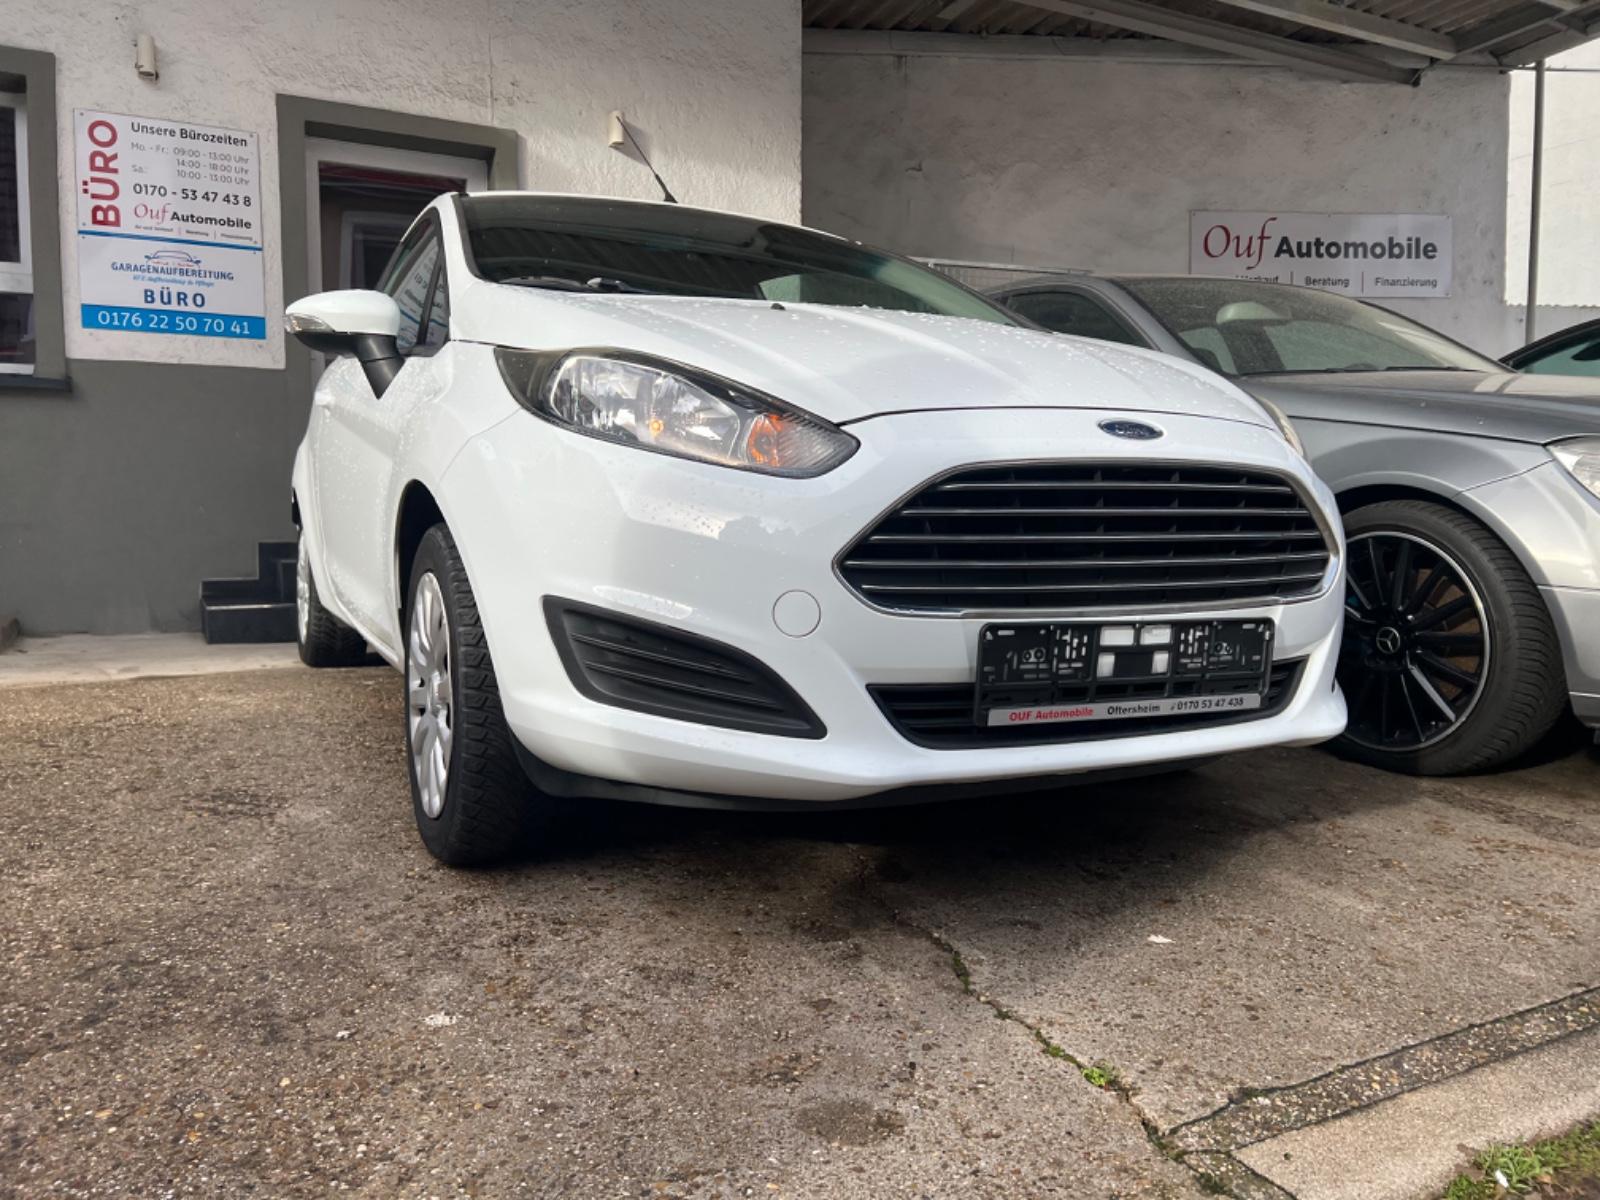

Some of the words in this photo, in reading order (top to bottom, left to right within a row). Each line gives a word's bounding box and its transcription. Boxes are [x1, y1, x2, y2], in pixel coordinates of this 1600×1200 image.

[131, 121, 176, 137] Unsere
[180, 127, 247, 147] Bürozeiten
[82, 119, 121, 228] BÜRO
[176, 158, 201, 169] 14:00
[132, 183, 168, 197] 0170
[181, 188, 198, 201] 53
[201, 191, 218, 203] 47
[222, 193, 239, 206] 43
[243, 195, 252, 207] 8
[134, 202, 171, 225] Ouf
[171, 211, 252, 229] Automobile
[1203, 217, 1277, 270] Ouf
[1274, 236, 1438, 260] Automobile
[111, 261, 234, 281] GARAGENAUFBEREITUNG
[1304, 276, 1350, 288] Beratung
[1374, 277, 1438, 289] Finanzierung
[143, 286, 206, 308] BÜRO
[98, 310, 143, 327] 0176
[149, 314, 169, 329] 22
[175, 316, 198, 331] 50
[203, 318, 225, 333] 70
[230, 320, 250, 335] 41
[1008, 710, 1033, 721] OUF
[1036, 706, 1094, 720] Automobile
[1177, 700, 1199, 711] 0170
[1201, 699, 1212, 709] 53
[1214, 698, 1226, 708] 47
